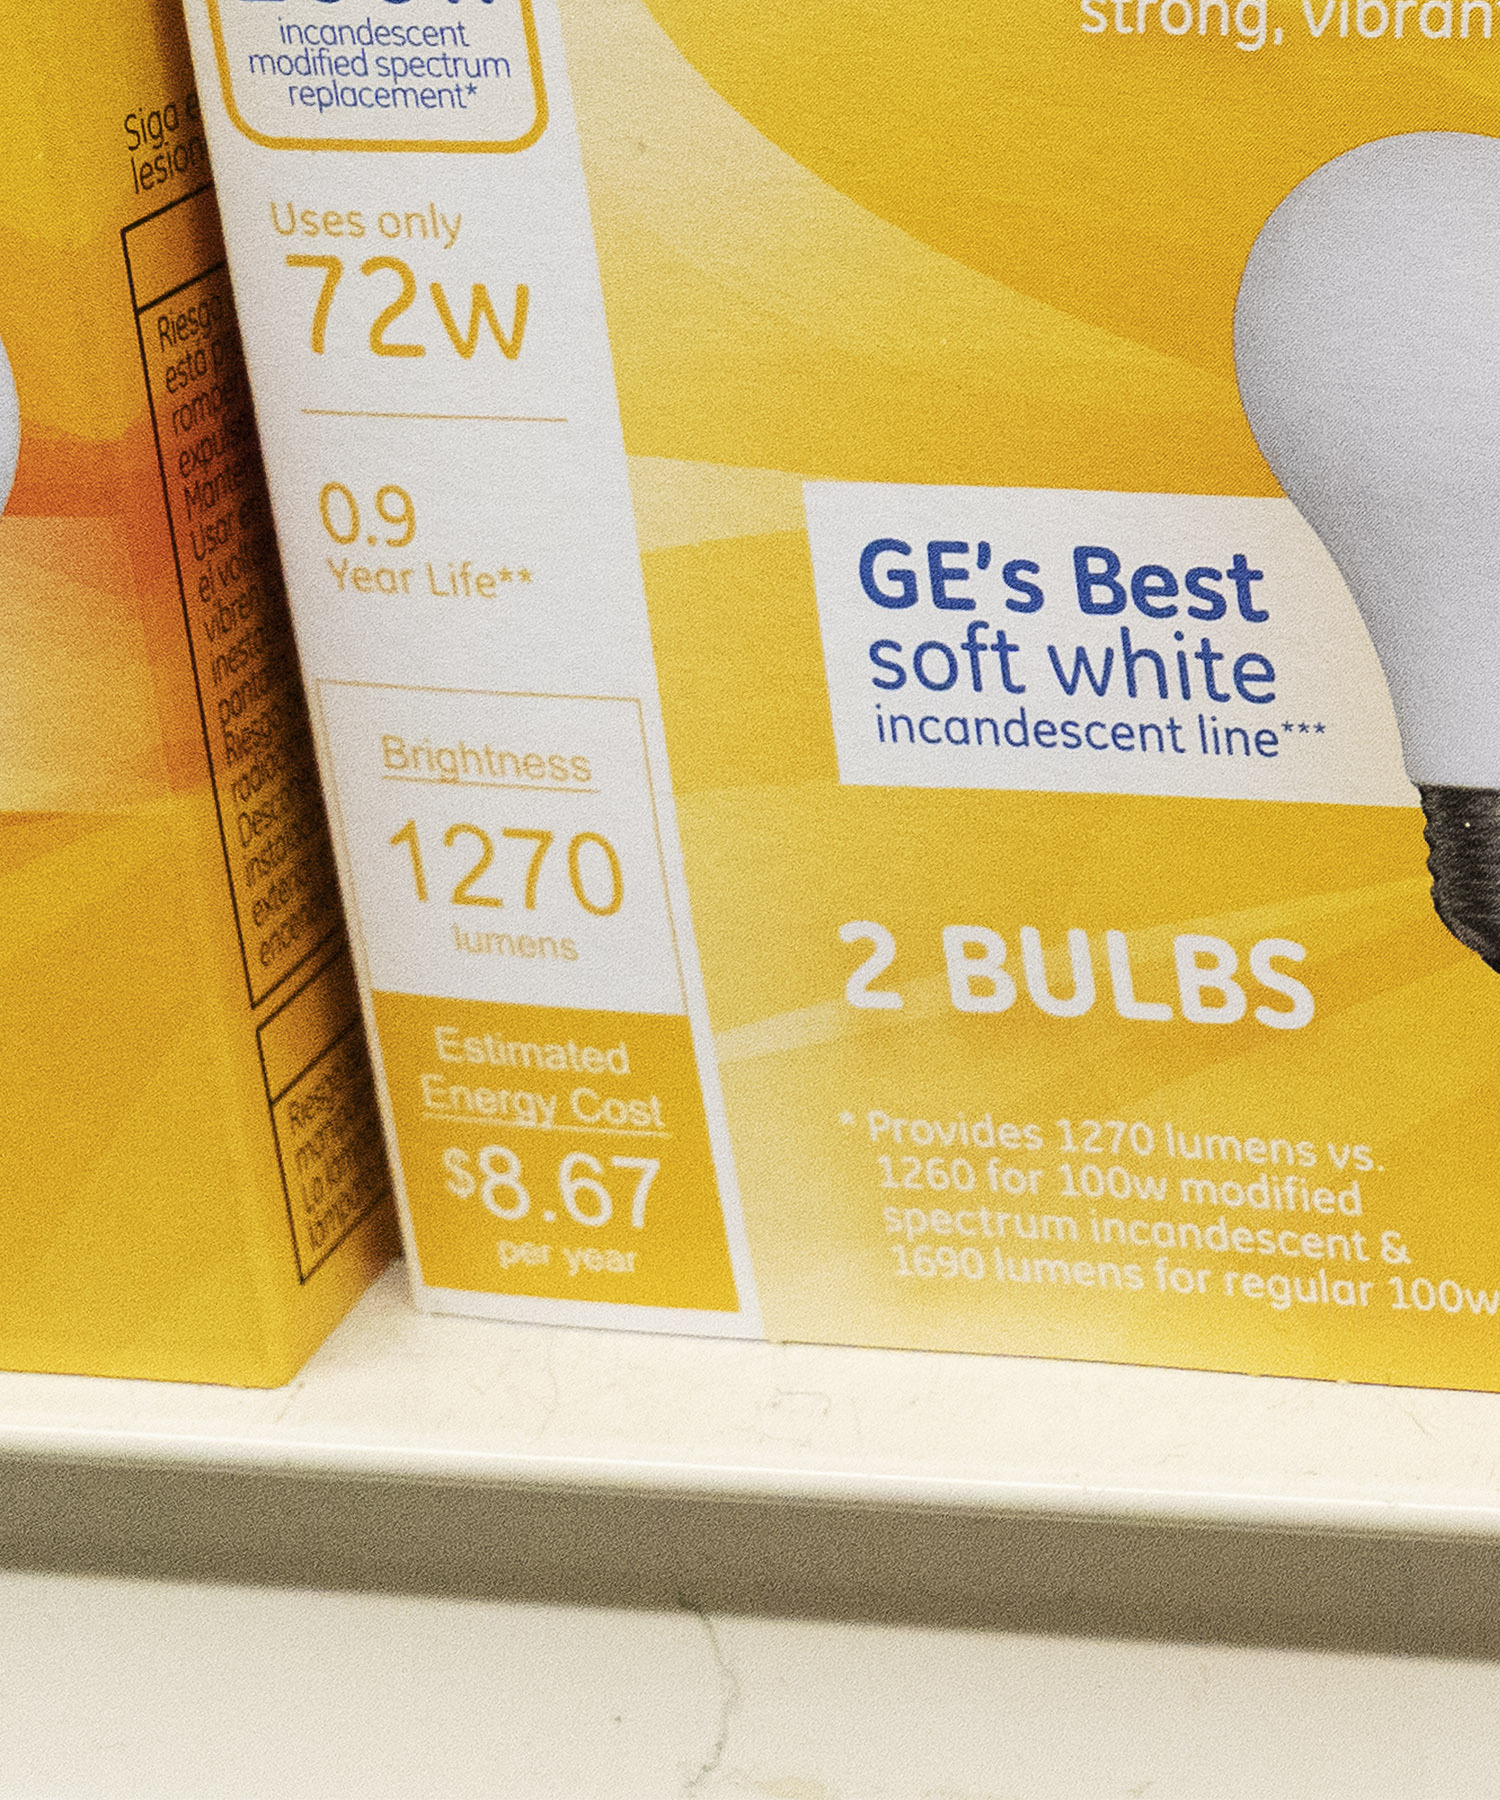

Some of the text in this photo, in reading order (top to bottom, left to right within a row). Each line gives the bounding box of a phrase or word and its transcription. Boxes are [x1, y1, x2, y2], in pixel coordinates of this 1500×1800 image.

[279, 17, 468, 47] incandescent
[249, 52, 511, 81] modified spectrum
[271, 201, 462, 250] Uses only
[286, 255, 529, 360] 72w
[321, 482, 416, 547] 0.9
[329, 557, 414, 596] Year
[859, 538, 1269, 622] GE's Best
[870, 621, 1277, 703] soft white
[877, 705, 1185, 753] incandescent
[383, 734, 591, 784] Brightness
[390, 820, 624, 917] 1270
[454, 923, 579, 961] lumens
[839, 921, 1315, 1029] 2 BULBS
[435, 1026, 630, 1075] Estimated
[422, 1076, 664, 1128] Energy Cost
[1056, 1117, 1153, 1156] 1270
[1165, 1123, 1316, 1166] lumens
[1329, 1134, 1385, 1173] vs.
[444, 1145, 660, 1229] $8.67
[879, 1155, 1362, 1216] 1260 for 100w modified
[496, 1237, 636, 1275] per year
[884, 1205, 1411, 1263] spectrum incandescent &
[893, 1246, 983, 1283] 1690
[994, 1249, 1143, 1290] lumens
[1154, 1258, 1212, 1296] for
[1224, 1270, 1373, 1310] regular
